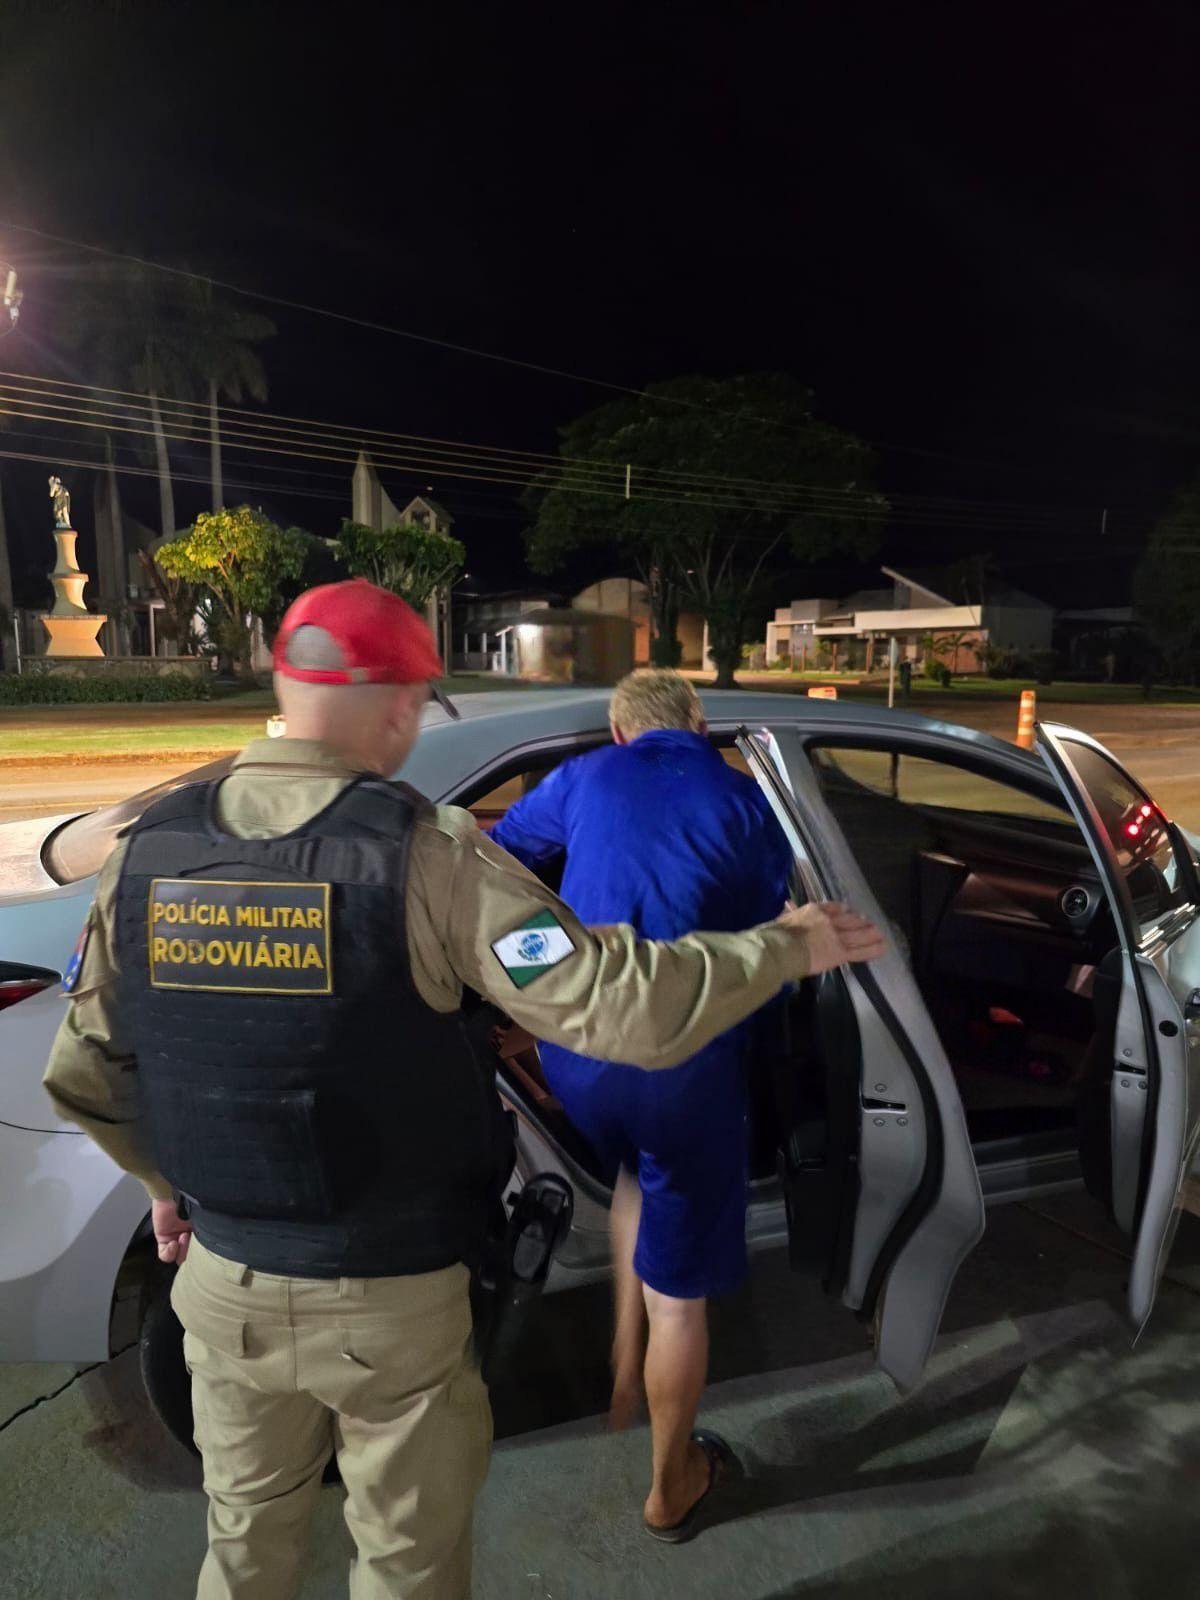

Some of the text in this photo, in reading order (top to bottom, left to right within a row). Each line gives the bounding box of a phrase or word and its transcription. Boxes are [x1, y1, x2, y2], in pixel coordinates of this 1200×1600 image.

[153, 897, 322, 928] POLÍCIA MILITAR
[154, 934, 324, 969] RODOVIÁRIA
